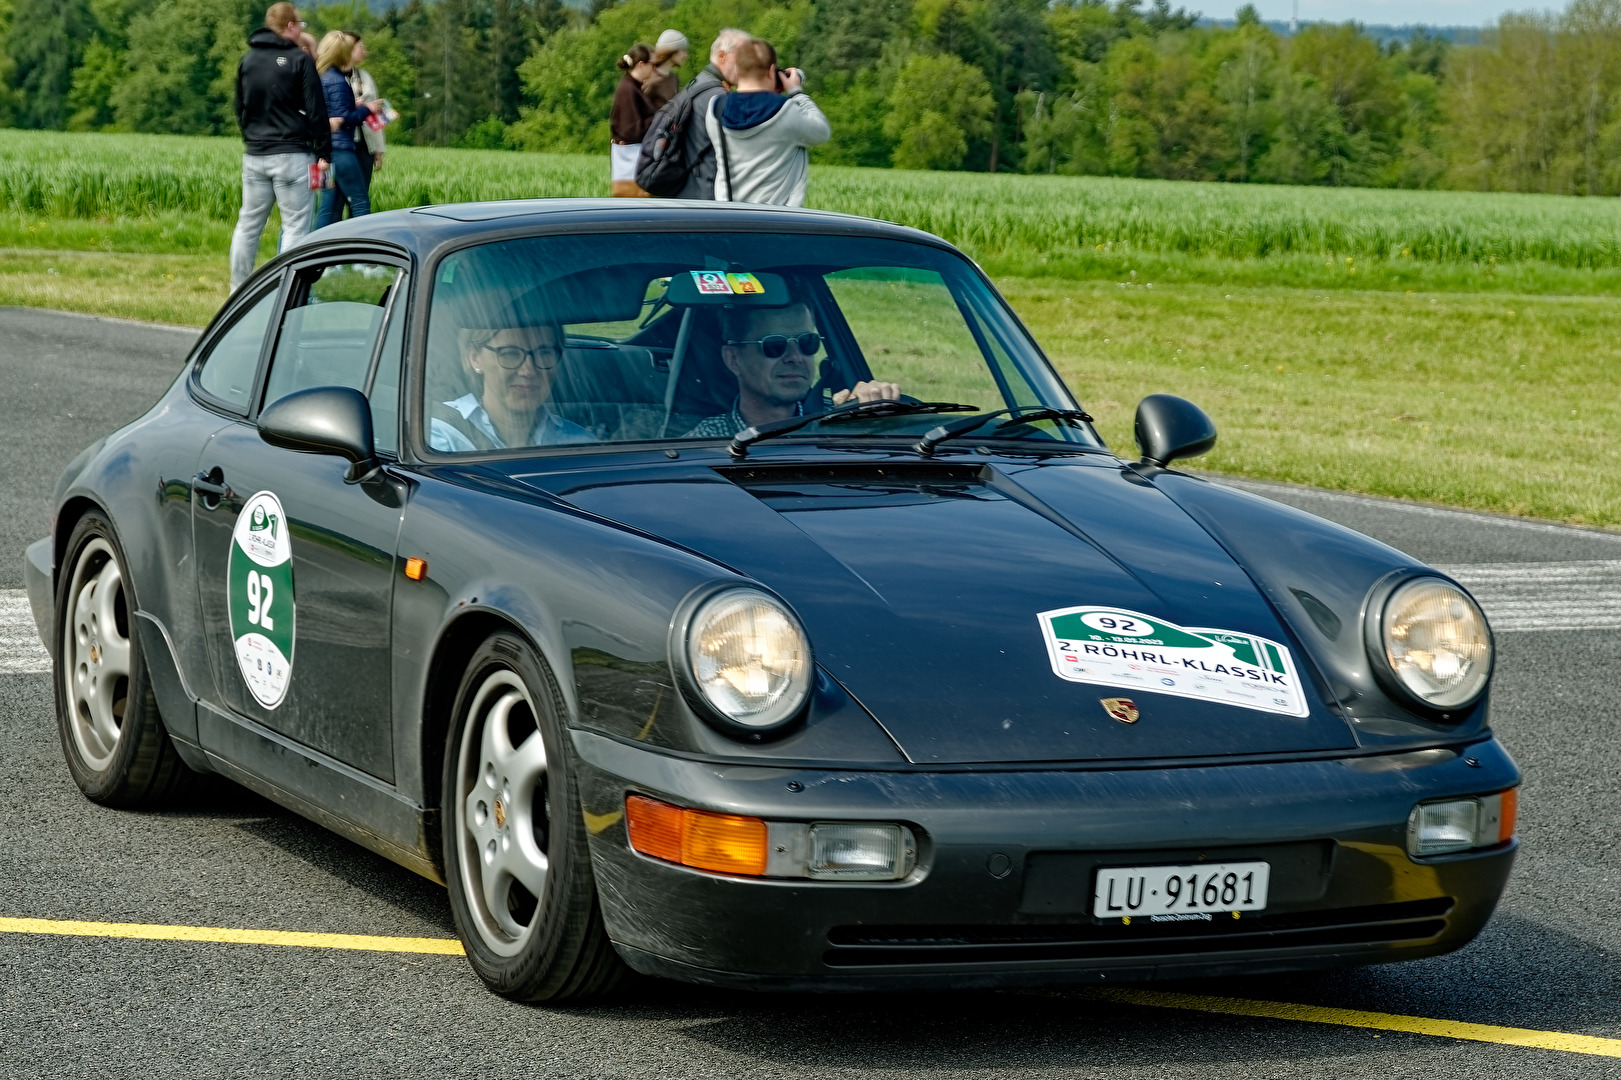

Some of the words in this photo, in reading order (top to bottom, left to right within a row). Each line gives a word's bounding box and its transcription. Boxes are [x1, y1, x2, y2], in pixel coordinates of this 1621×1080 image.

[247, 569, 274, 631] 92
[1099, 617, 1138, 632] 92
[1058, 641, 1078, 652] 2.
